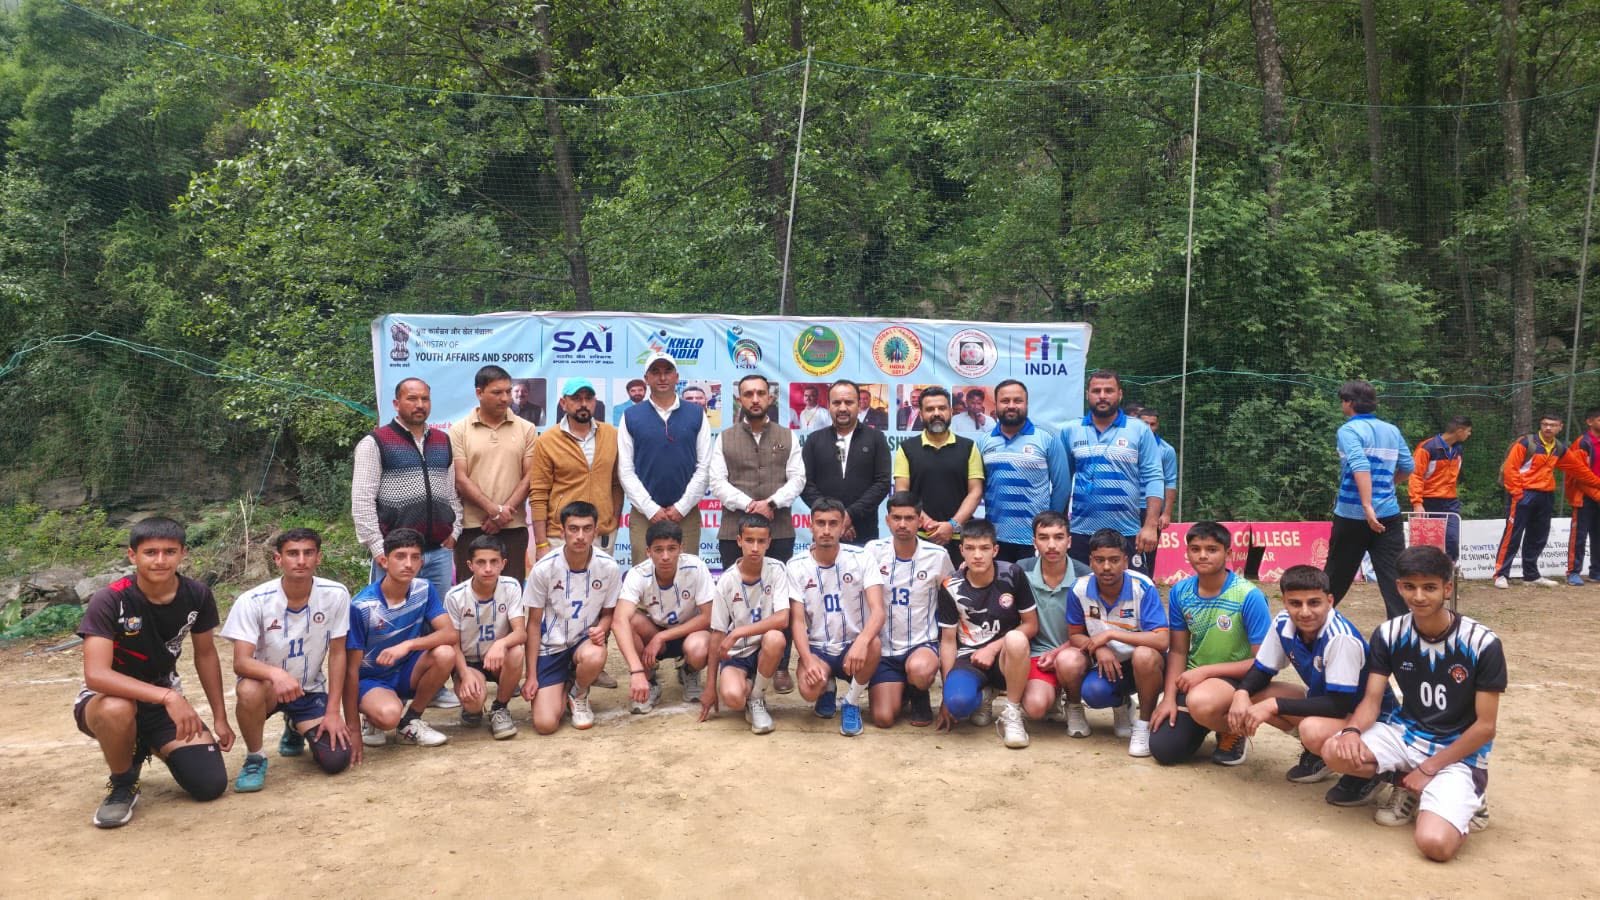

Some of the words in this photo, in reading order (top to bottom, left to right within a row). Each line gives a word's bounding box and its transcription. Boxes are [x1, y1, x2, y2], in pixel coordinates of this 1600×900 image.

[415, 341, 447, 349] MINISTRY
[449, 341, 459, 349] OF
[552, 331, 613, 353] SAI
[668, 338, 704, 349] KHELO
[415, 353, 444, 362] YOUTH
[446, 353, 480, 362] AFFAIRS
[482, 353, 500, 362] AND
[502, 353, 534, 363] SPORTS
[666, 348, 699, 360] INDIA
[1025, 363, 1068, 376] INDIA
[1234, 531, 1301, 548] COLLEGE
[824, 594, 842, 612] 01
[891, 588, 910, 606] 13
[571, 601, 583, 619] 7
[667, 611, 678, 625] 2
[478, 624, 496, 642] 15
[288, 638, 305, 658] 11
[1420, 681, 1447, 710] 06
